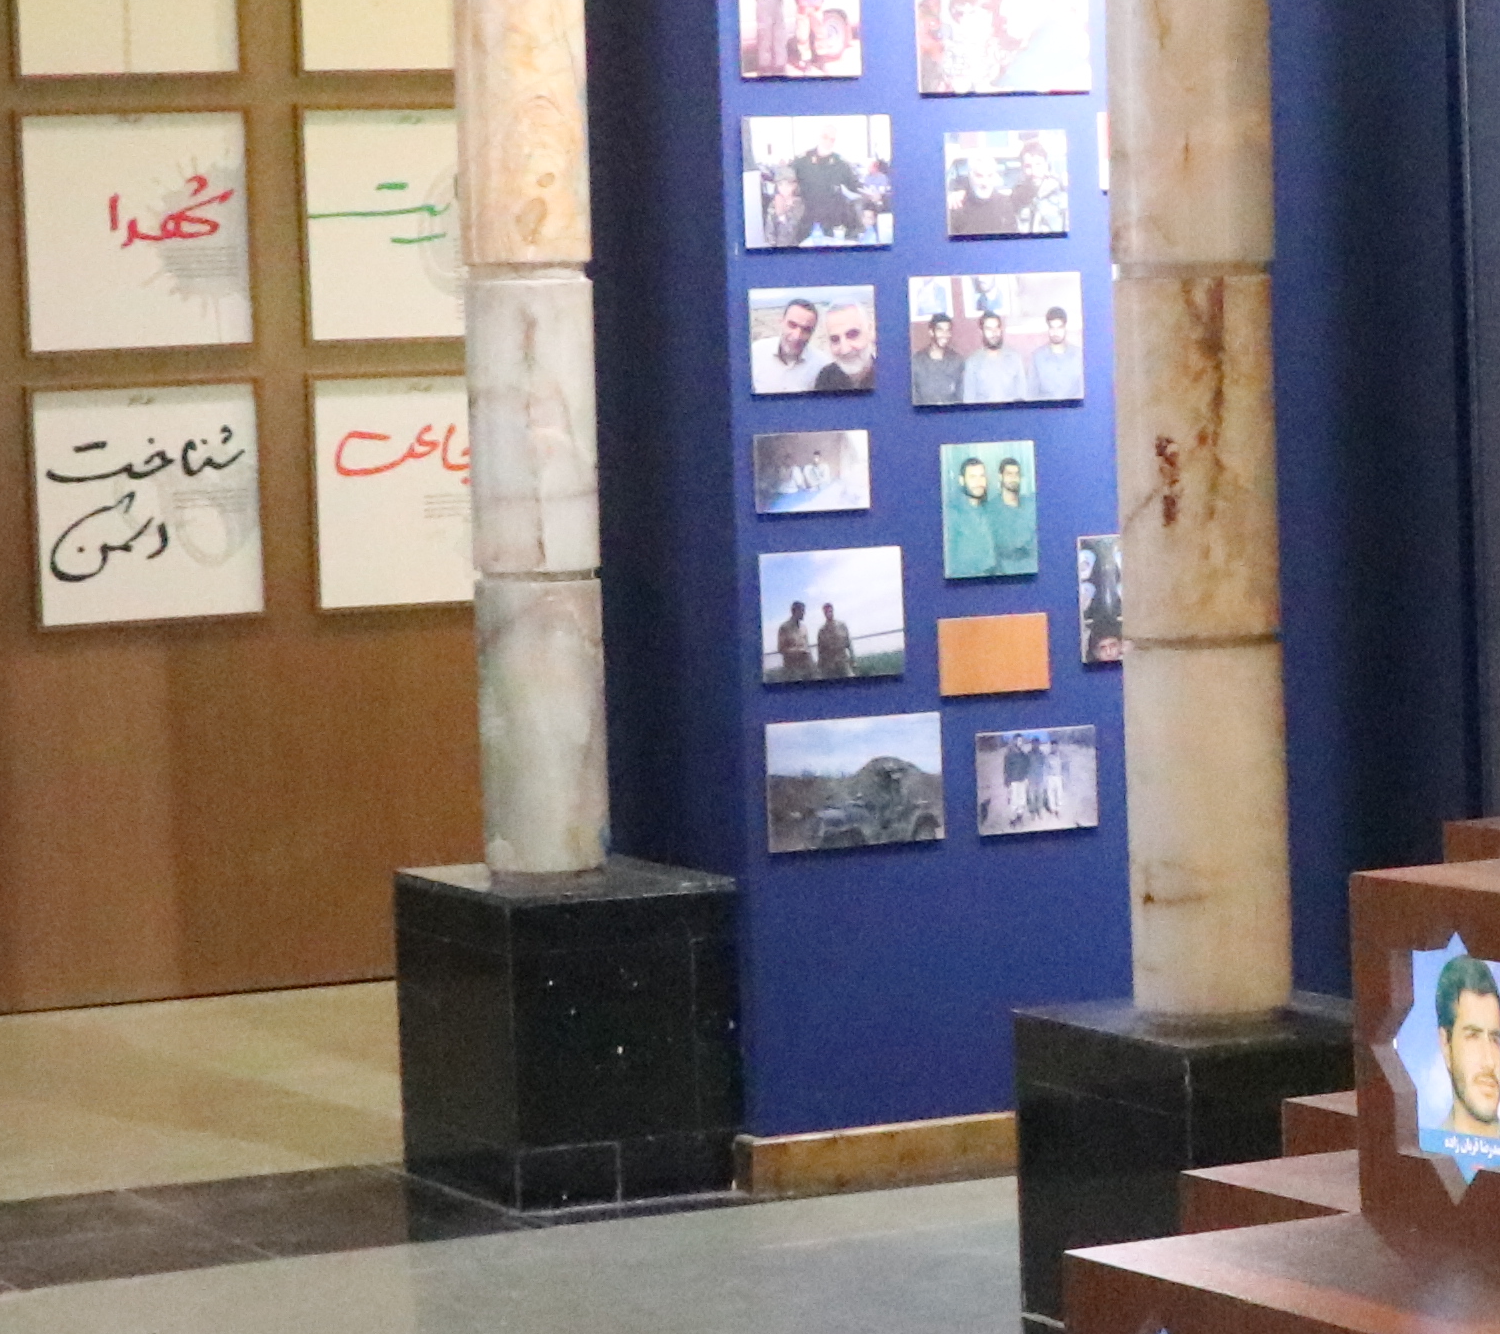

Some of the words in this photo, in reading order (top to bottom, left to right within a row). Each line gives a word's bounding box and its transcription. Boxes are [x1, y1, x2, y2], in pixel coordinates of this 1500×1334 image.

[108, 174, 235, 250] شهدا
[46, 425, 246, 484] شناخت
[49, 491, 169, 583] دشمن
